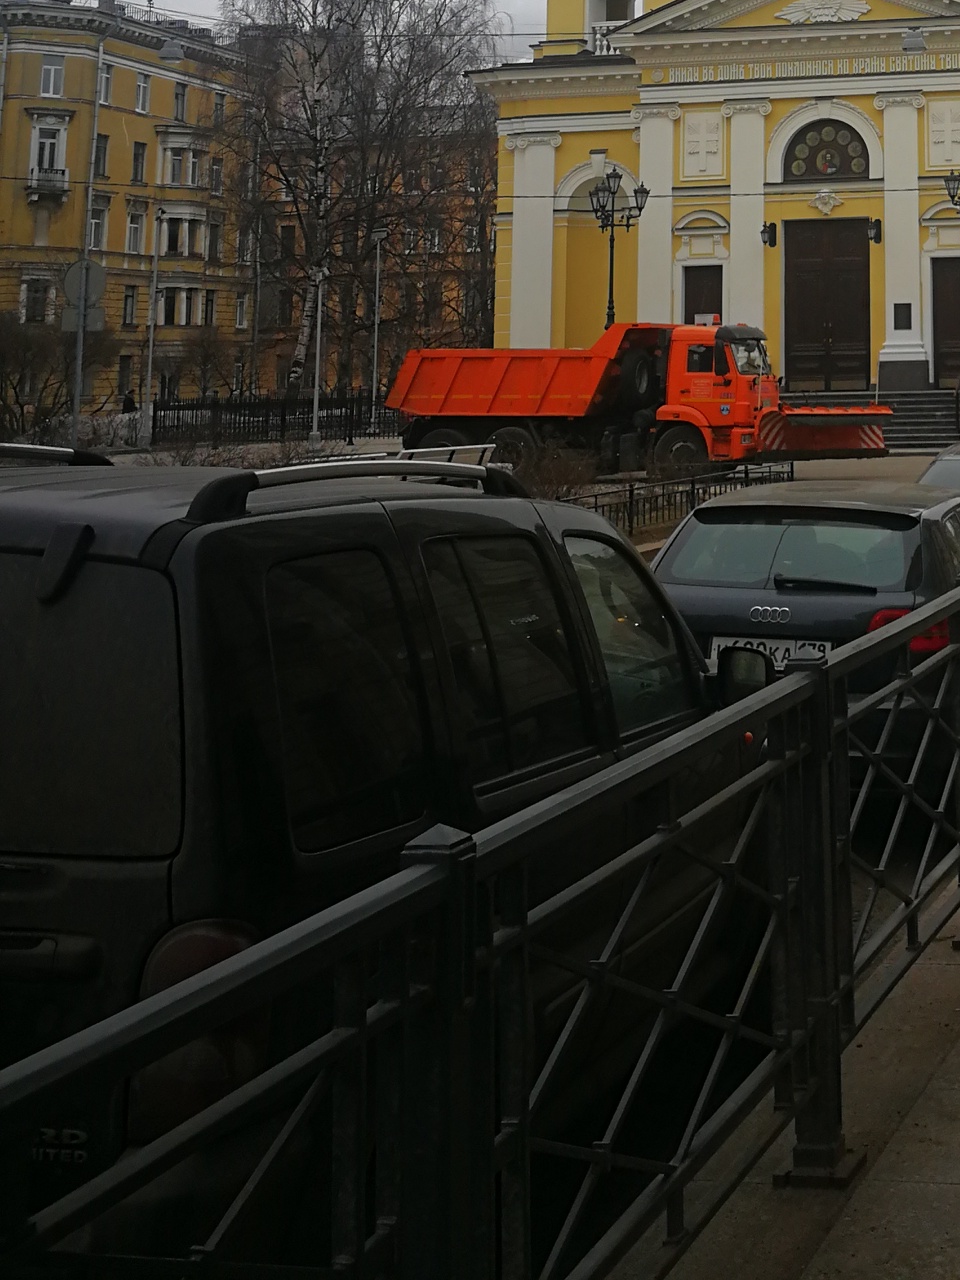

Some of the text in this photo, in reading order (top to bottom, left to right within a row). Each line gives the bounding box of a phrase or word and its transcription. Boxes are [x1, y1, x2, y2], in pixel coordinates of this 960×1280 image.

[837, 59, 849, 74] КО
[852, 55, 885, 73] ХРАМУ
[889, 53, 936, 71] СВЯТОМУ
